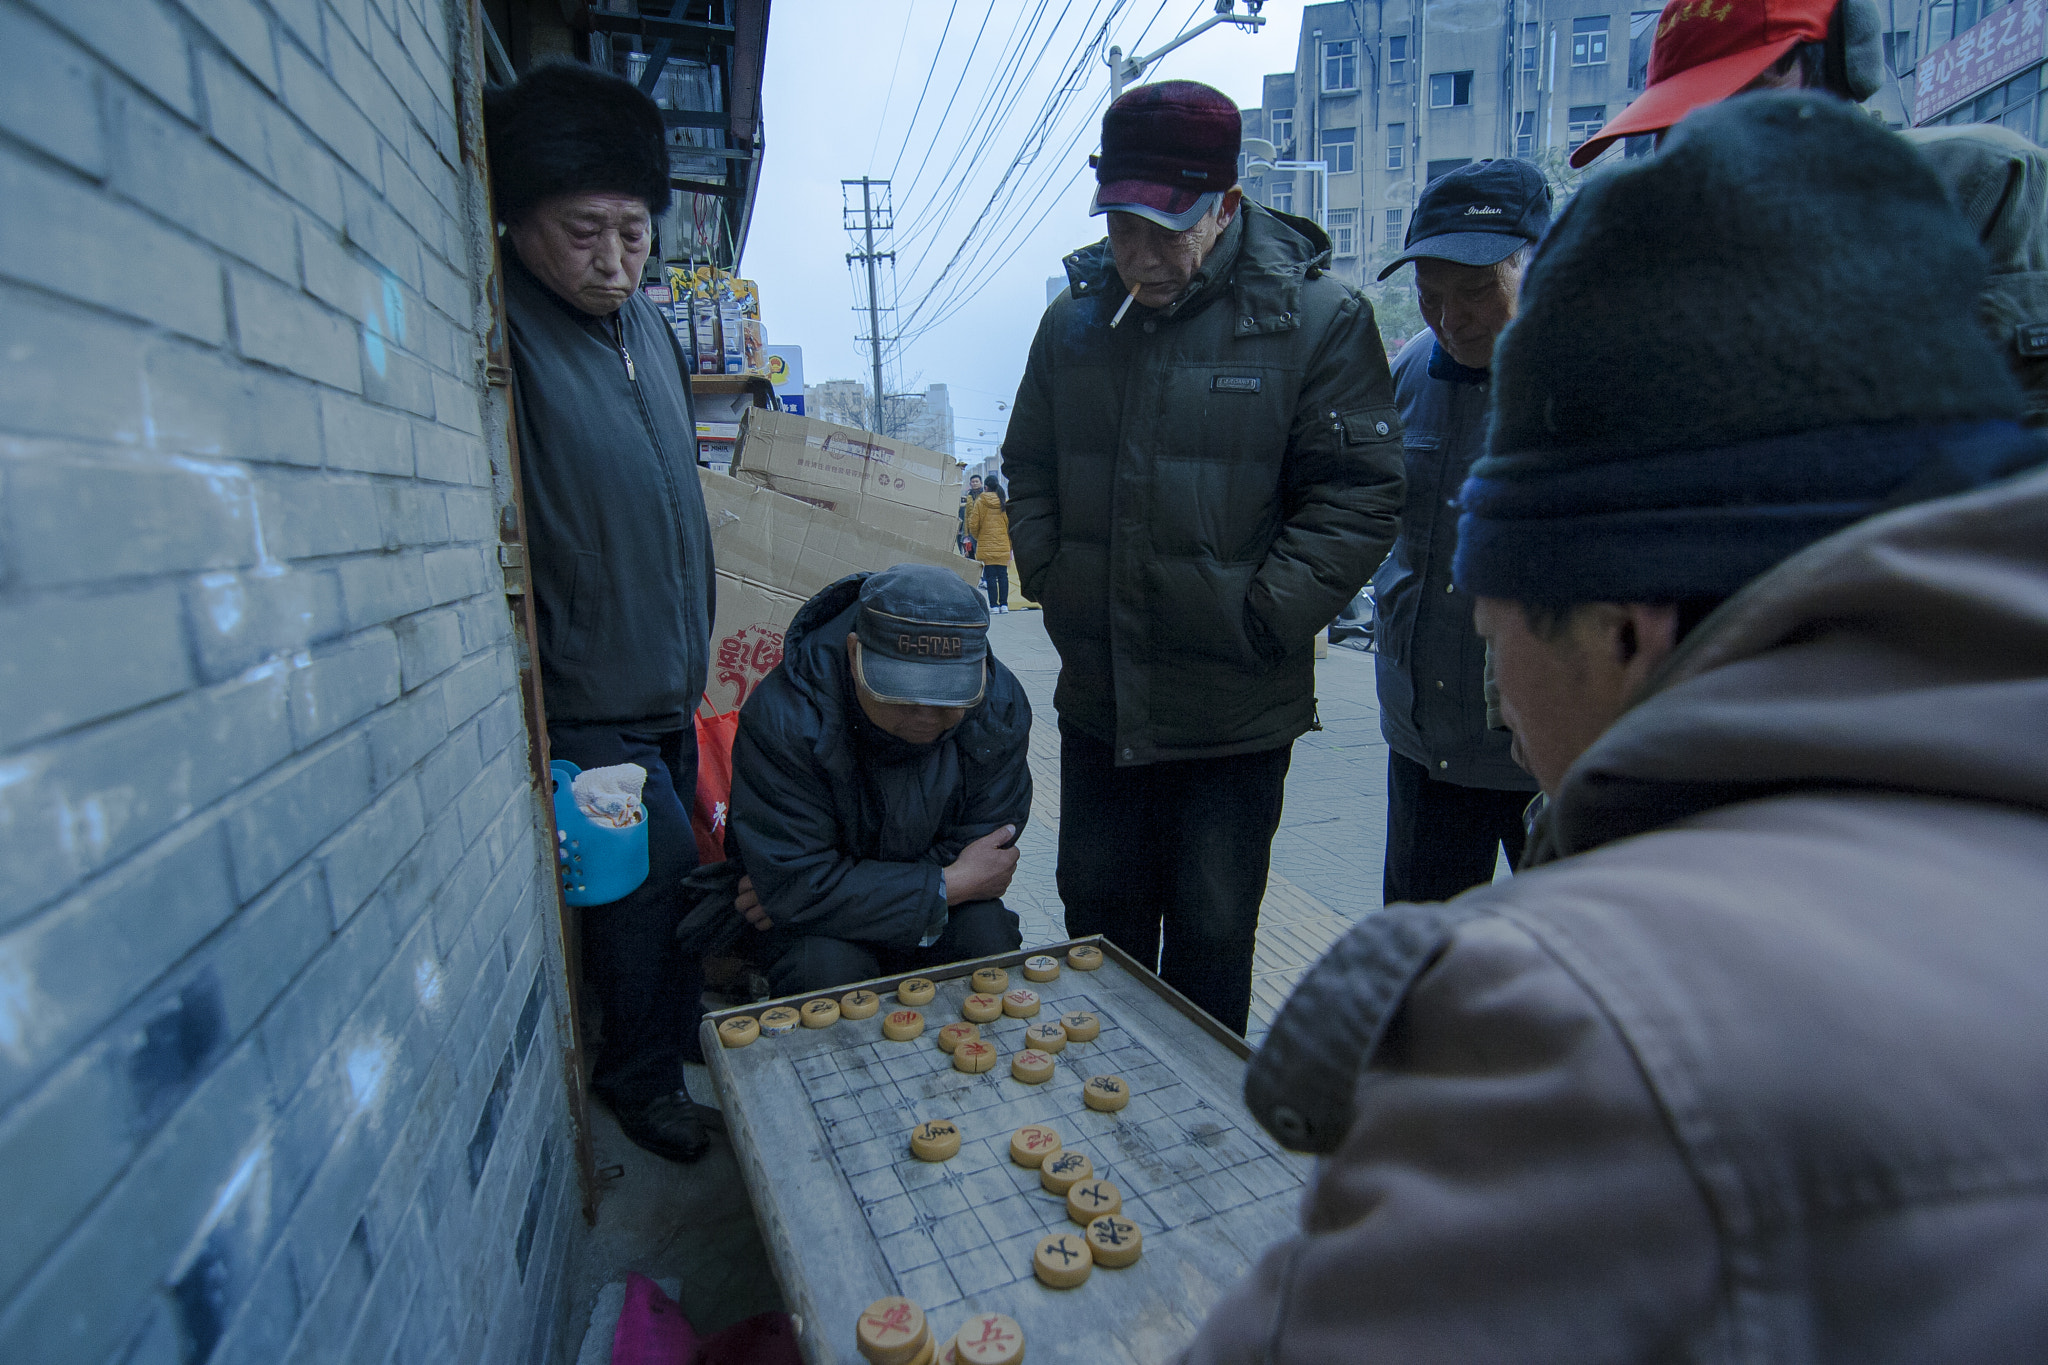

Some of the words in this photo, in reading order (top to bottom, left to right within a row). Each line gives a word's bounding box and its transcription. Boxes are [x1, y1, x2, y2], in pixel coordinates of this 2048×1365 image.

[1917, 0, 2043, 97] 爱心学生之家
[1463, 205, 1503, 216] Indian
[966, 1316, 1014, 1354] 兵
